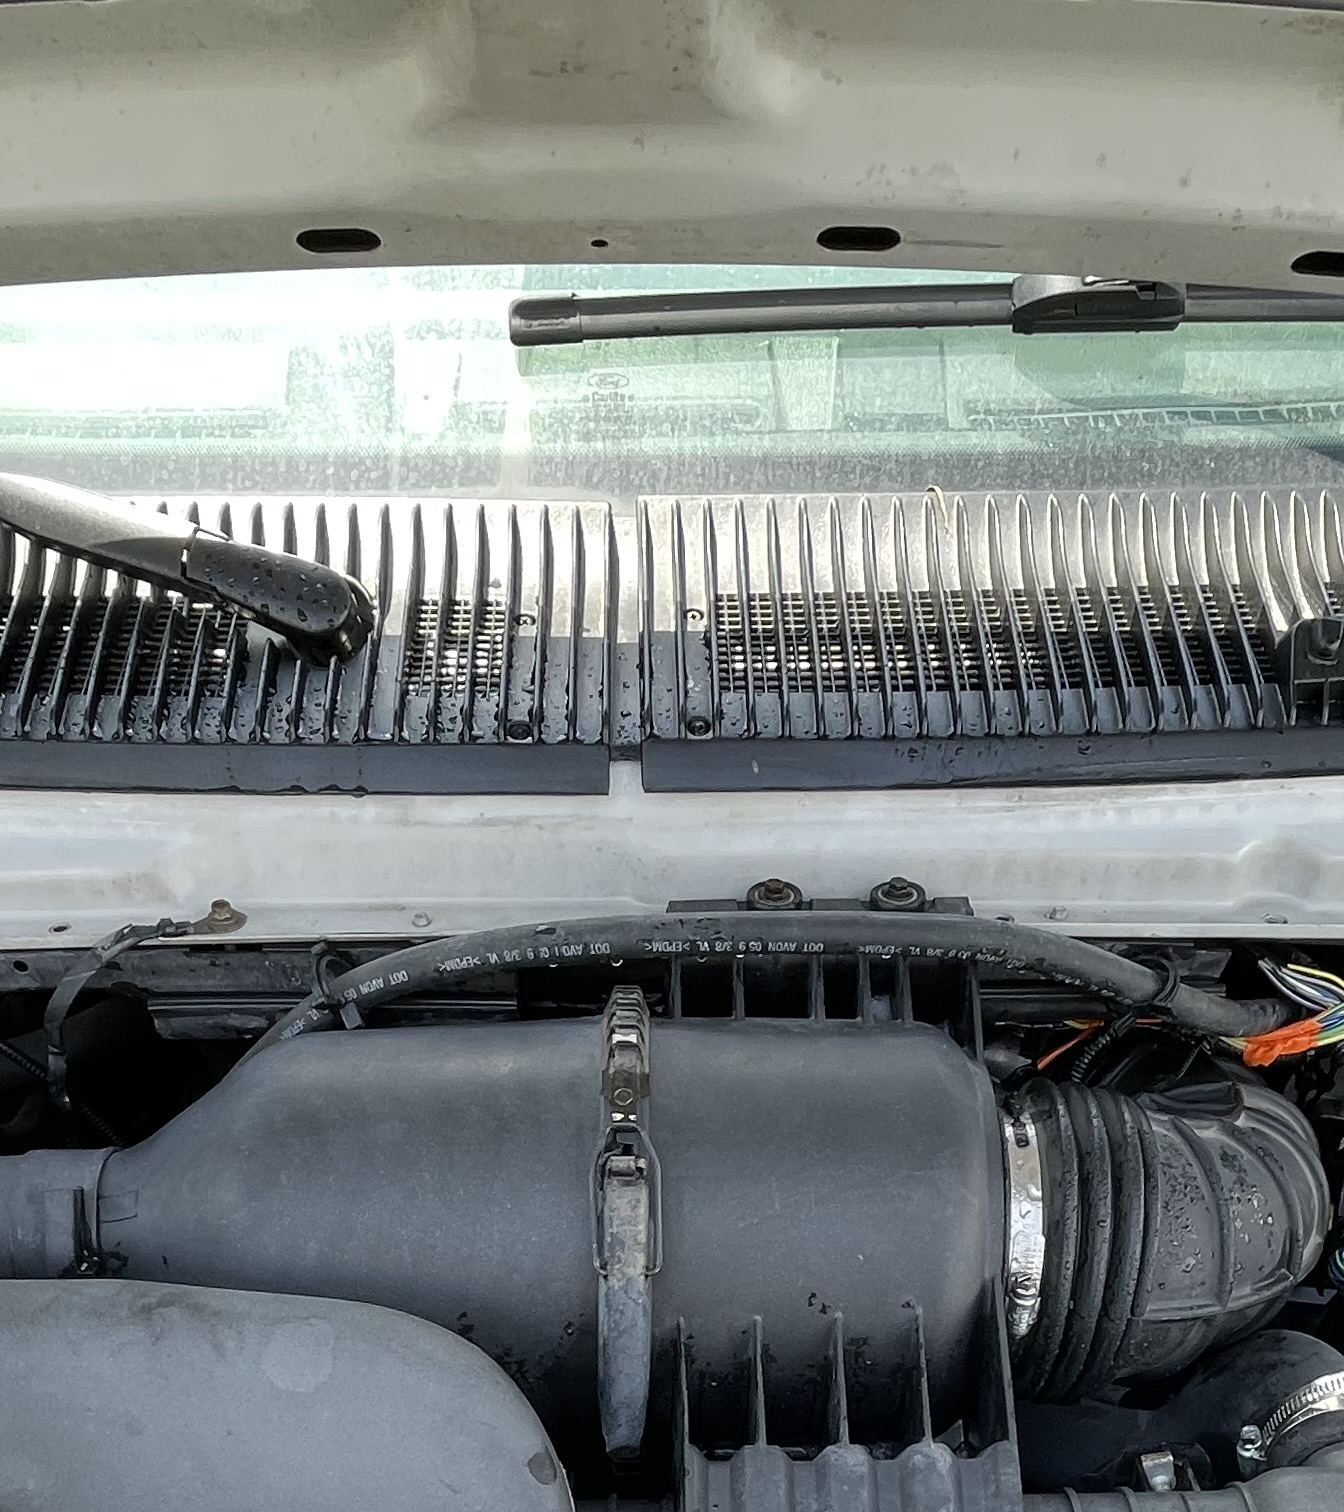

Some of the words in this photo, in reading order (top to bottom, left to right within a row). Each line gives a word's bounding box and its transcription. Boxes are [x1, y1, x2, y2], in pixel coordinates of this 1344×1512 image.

[768, 941, 797, 952] AVON
[802, 942, 824, 953] DOT
[388, 969, 409, 986] DOT
[358, 976, 385, 995] AVON
